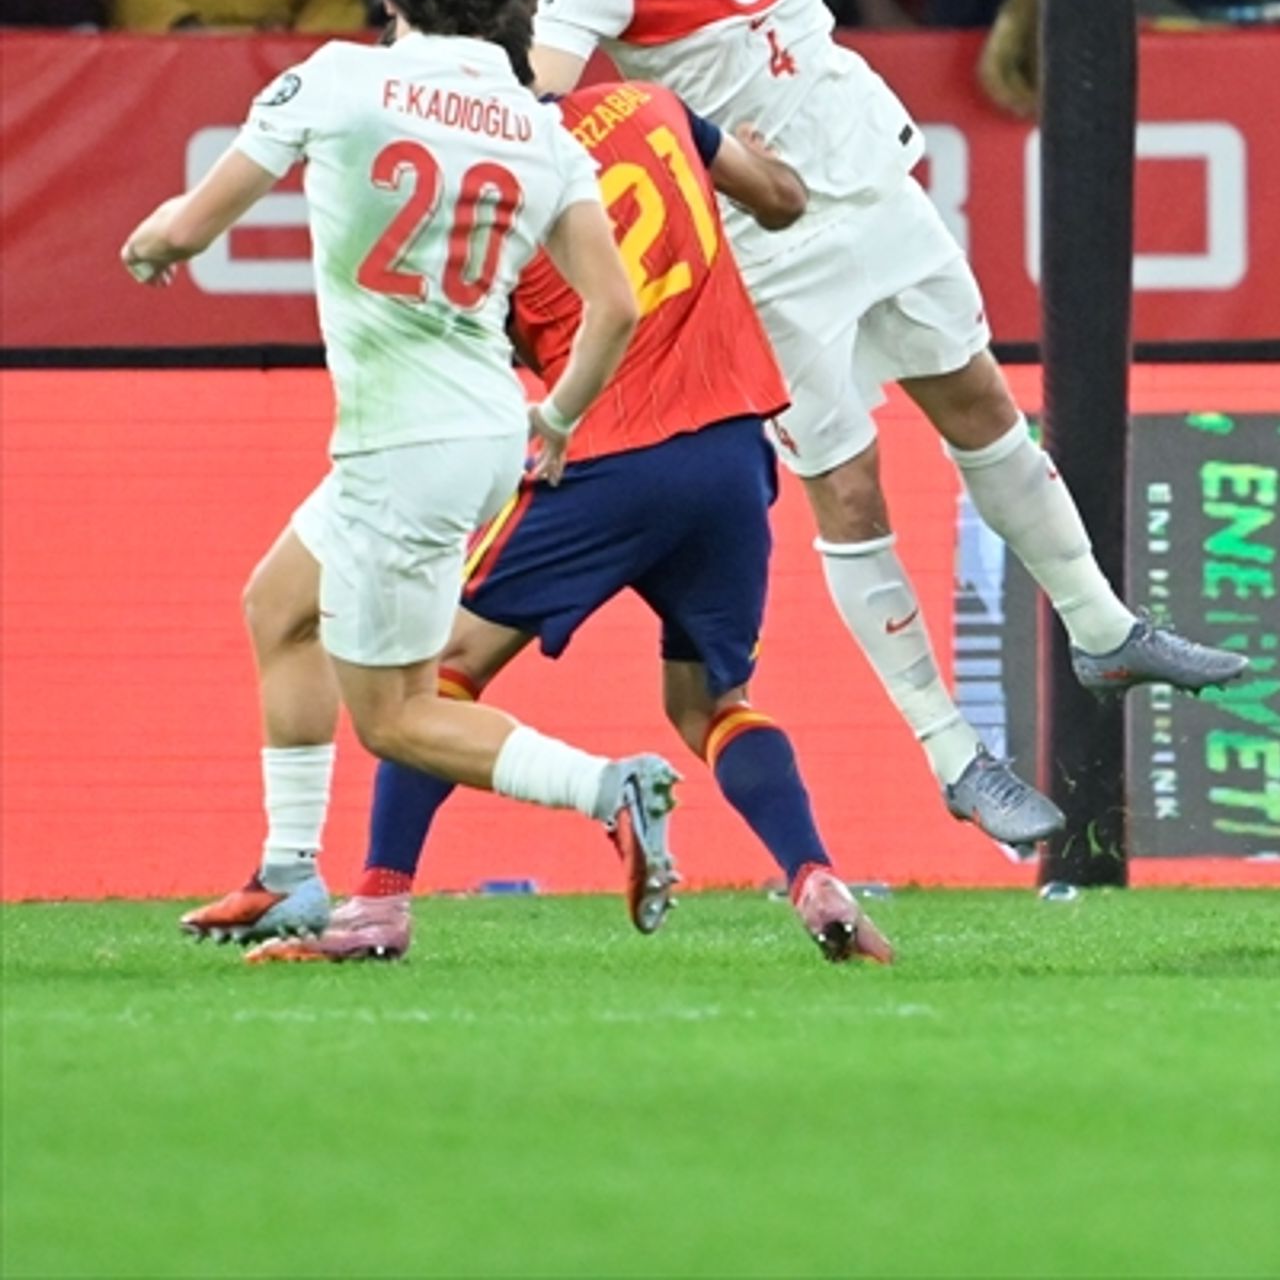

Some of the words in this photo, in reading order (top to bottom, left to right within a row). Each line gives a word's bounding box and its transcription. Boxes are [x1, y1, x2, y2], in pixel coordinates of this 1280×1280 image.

[383, 79, 533, 143] F.KADIOĞLU
[767, 29, 796, 78] 4
[357, 140, 525, 310] 20
[598, 124, 718, 316] 21
